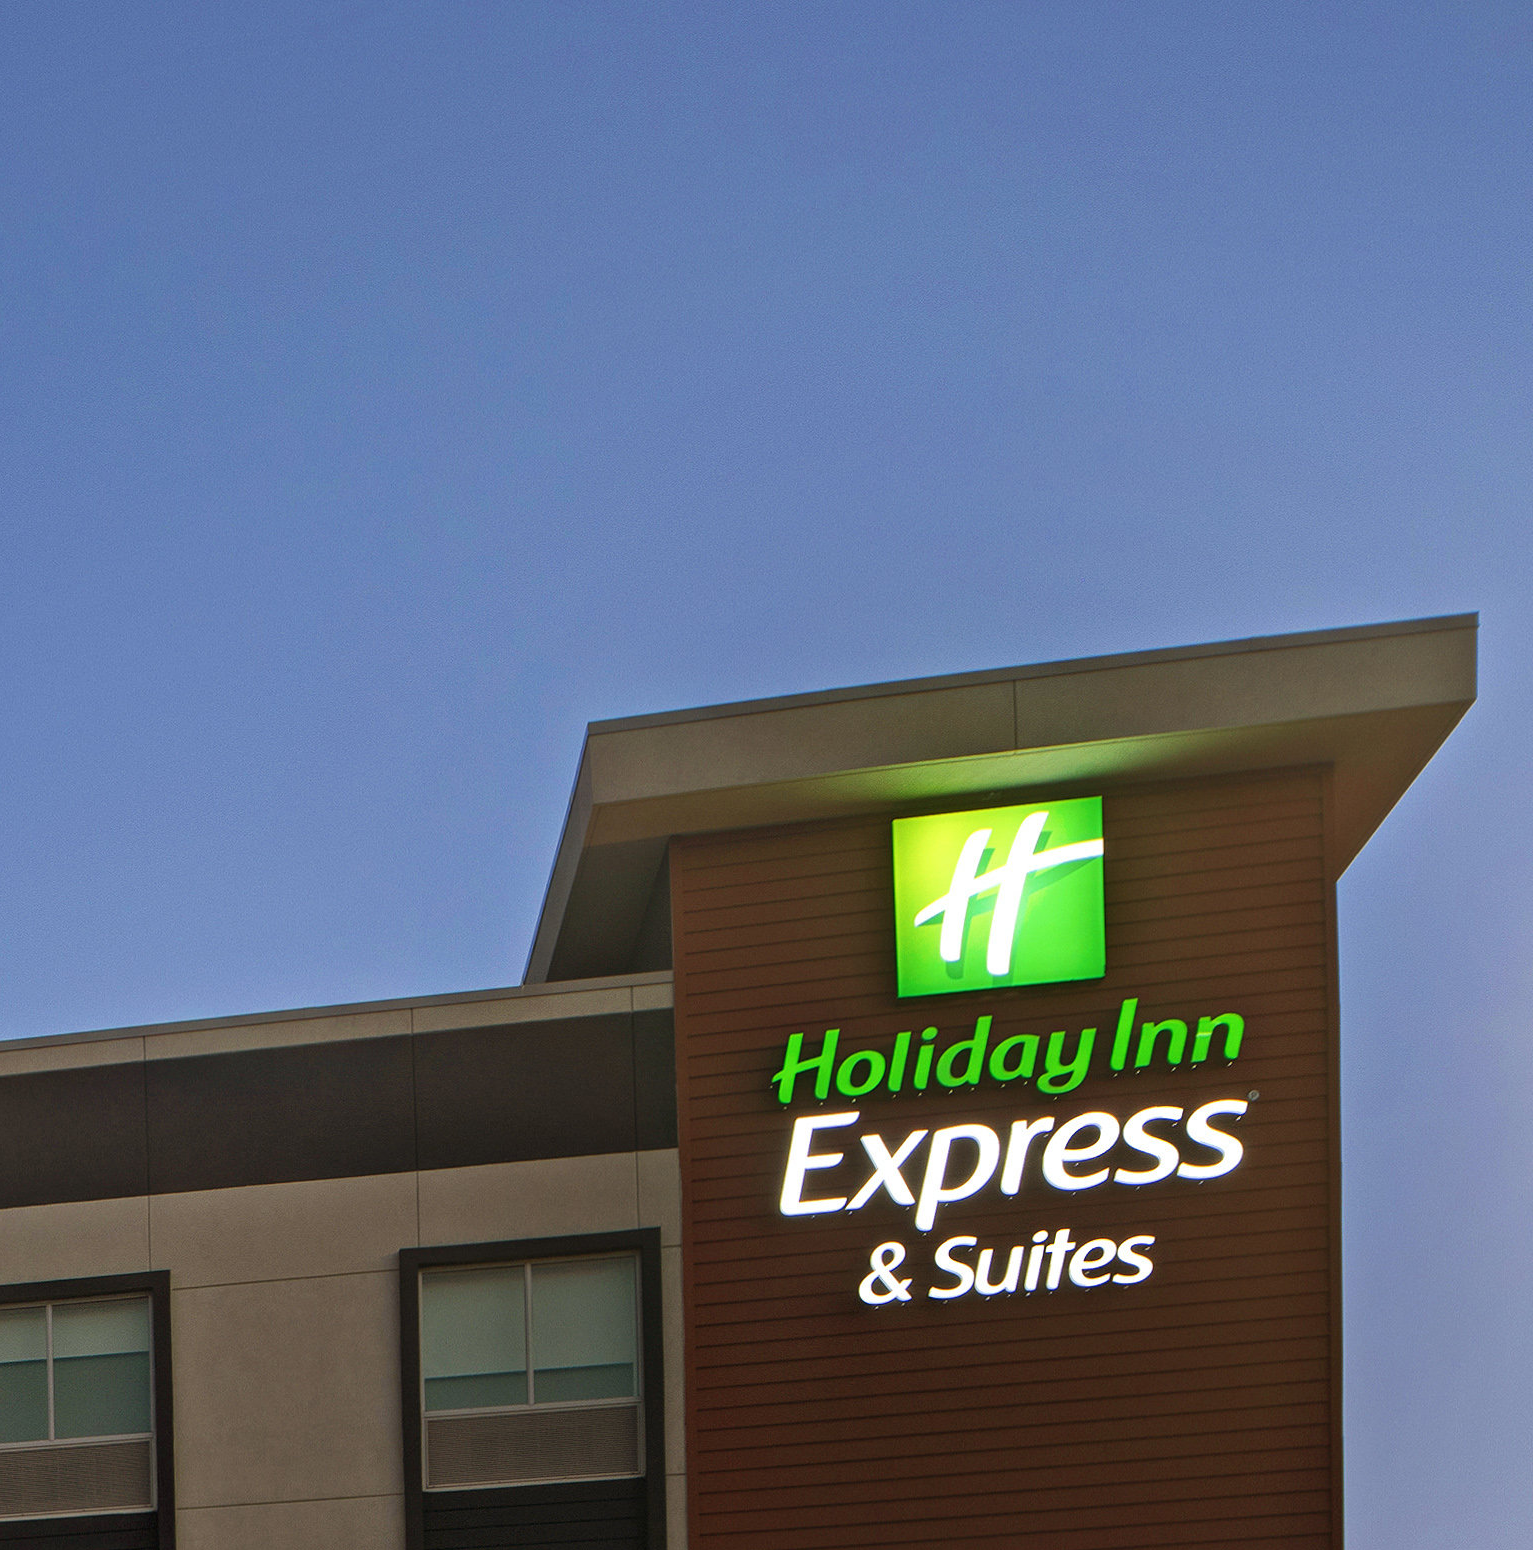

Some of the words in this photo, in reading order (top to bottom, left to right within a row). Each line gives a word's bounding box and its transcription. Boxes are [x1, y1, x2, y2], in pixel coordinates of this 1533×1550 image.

[772, 1015, 1096, 1103] Holiday
[1110, 998, 1245, 1071] Inn
[779, 1098, 1249, 1232] Express
[858, 1241, 913, 1305] &
[928, 1229, 1156, 1300] Suites
